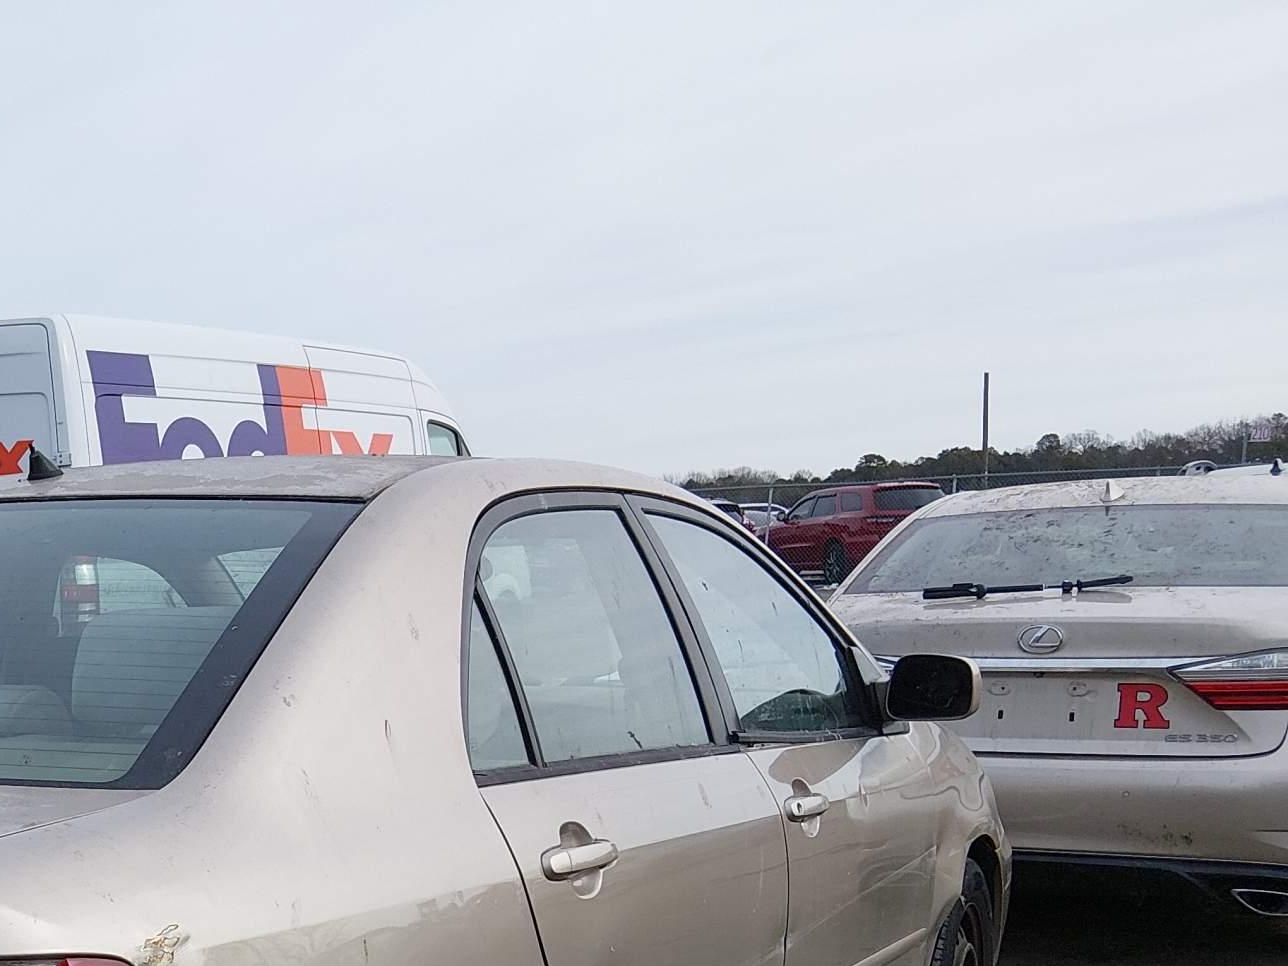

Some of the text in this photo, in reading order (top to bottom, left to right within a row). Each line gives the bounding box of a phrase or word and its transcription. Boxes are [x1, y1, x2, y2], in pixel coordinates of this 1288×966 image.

[1114, 683, 1170, 729] R
[1164, 734, 1239, 743] ES 350
